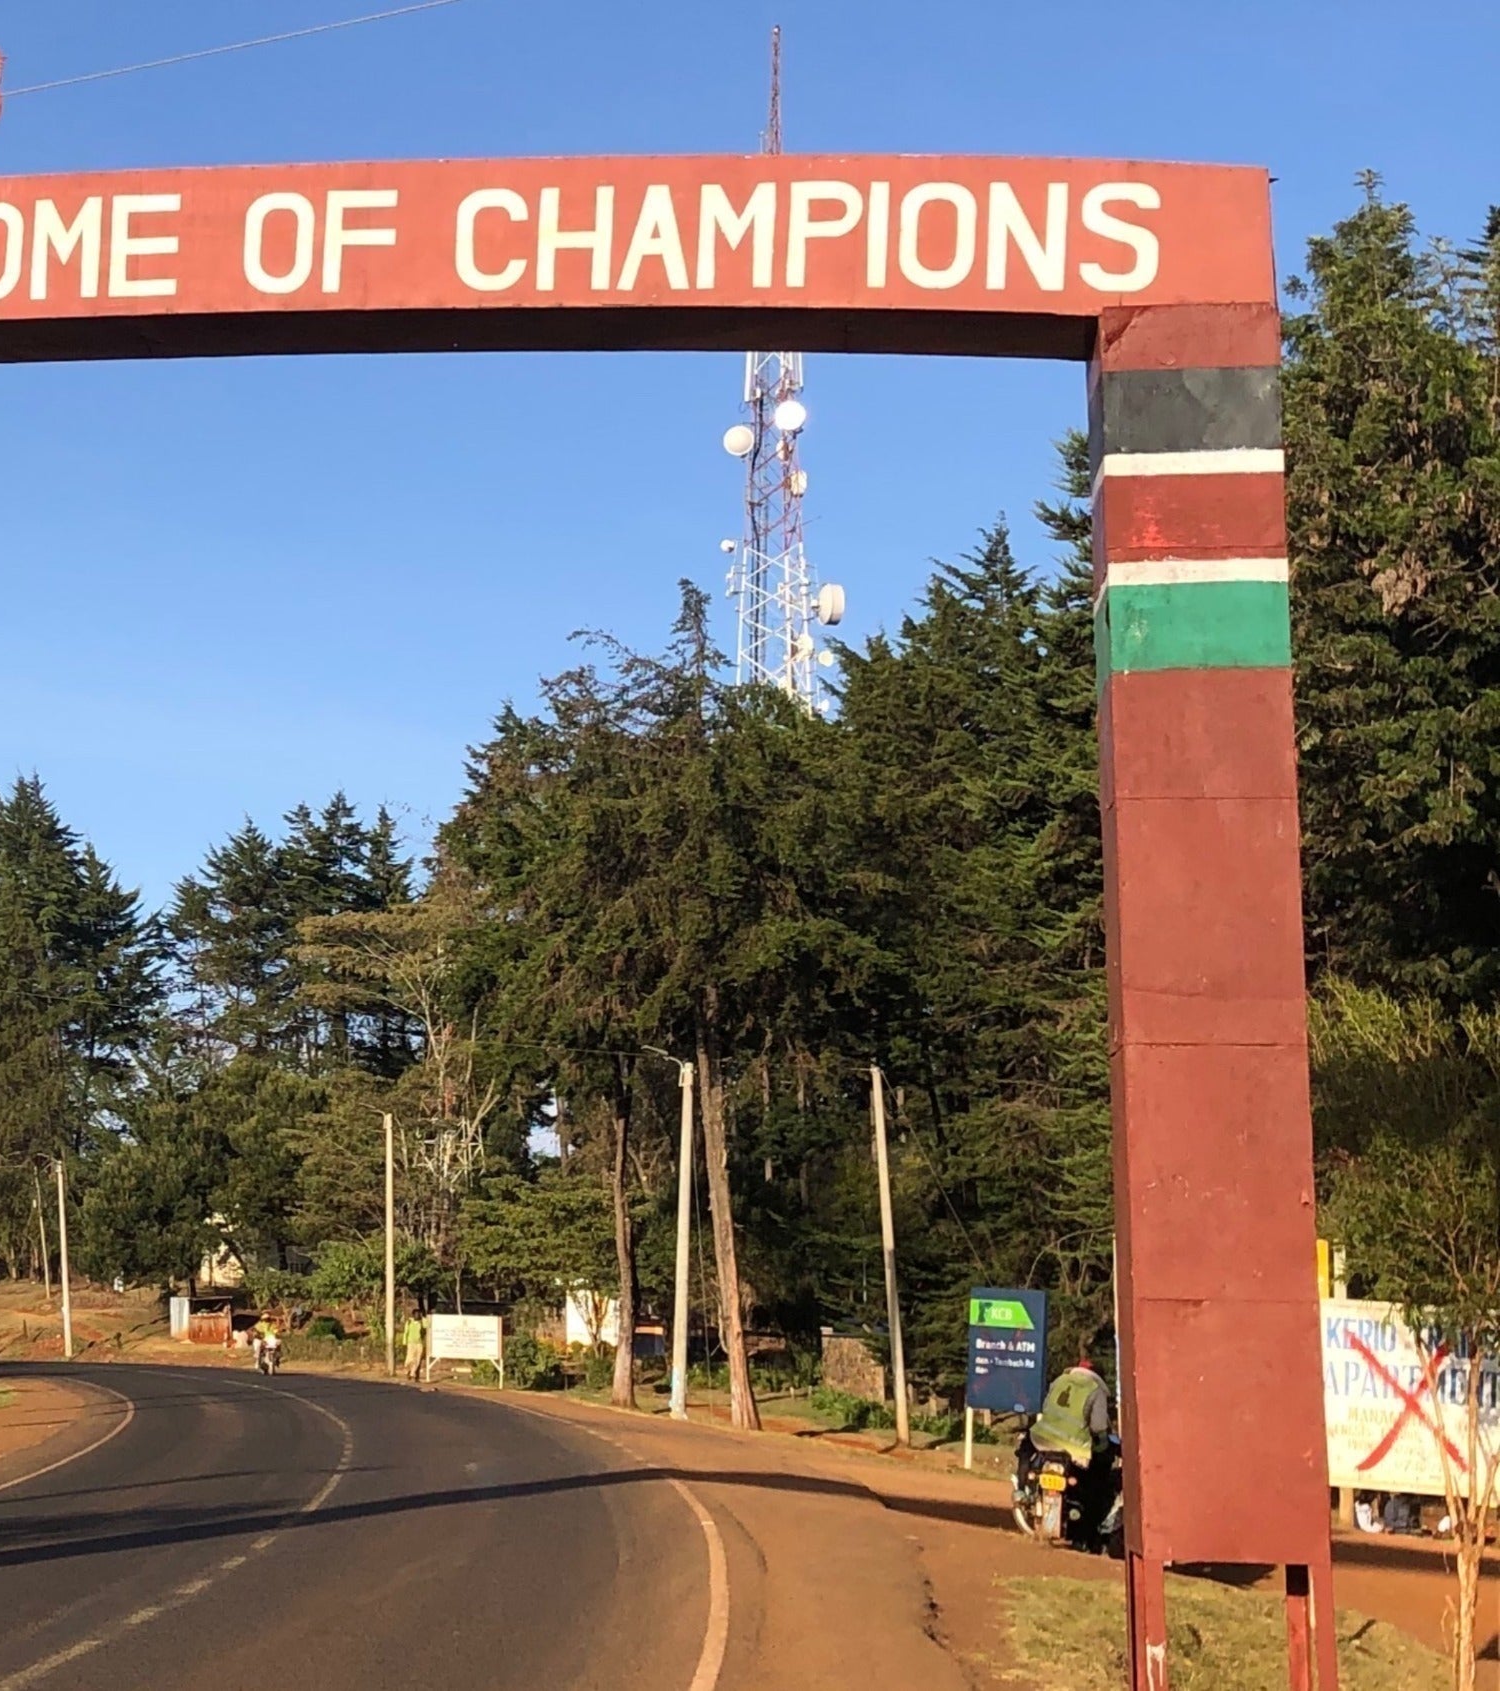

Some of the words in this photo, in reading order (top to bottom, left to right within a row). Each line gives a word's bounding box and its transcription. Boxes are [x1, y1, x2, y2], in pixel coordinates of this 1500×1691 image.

[244, 189, 398, 294] OF
[455, 180, 1161, 292] CHAMPIONS
[991, 1308, 1013, 1321] KCB
[975, 1338, 1006, 1350] Branch
[1015, 1341, 1036, 1353] ATM
[1326, 1317, 1397, 1352] KERIO
